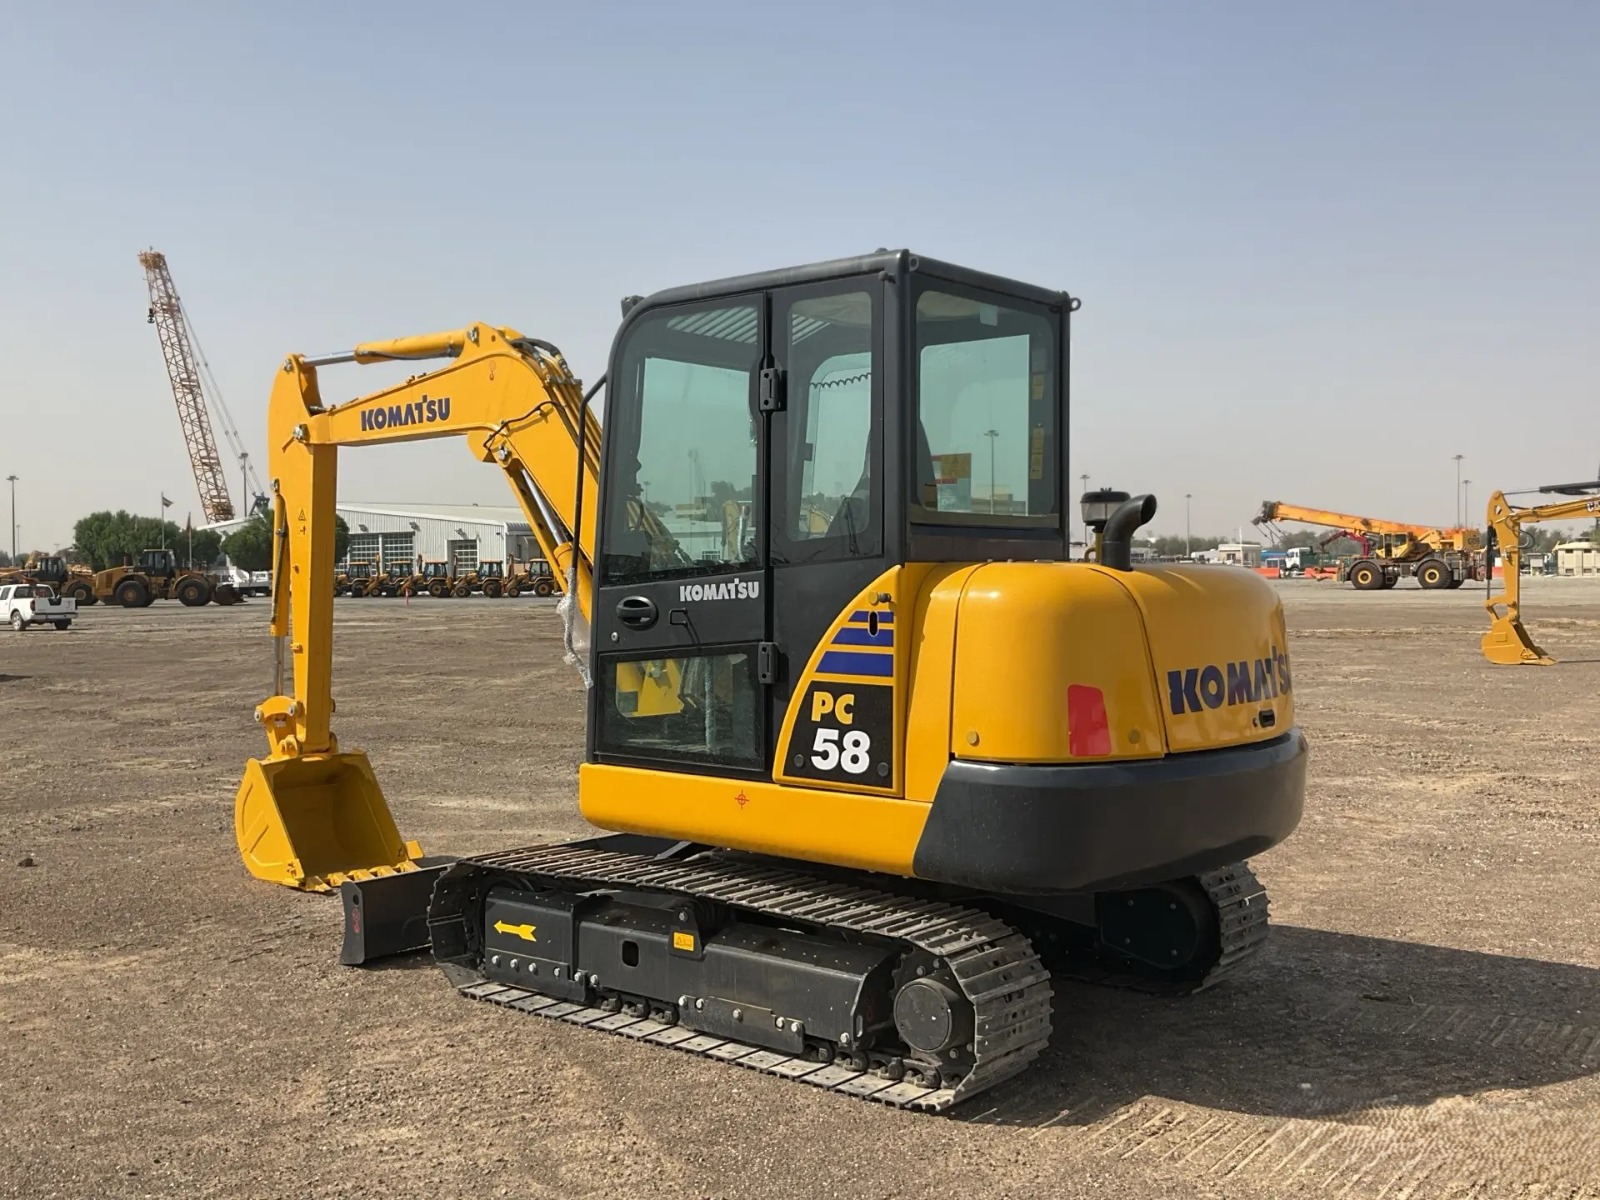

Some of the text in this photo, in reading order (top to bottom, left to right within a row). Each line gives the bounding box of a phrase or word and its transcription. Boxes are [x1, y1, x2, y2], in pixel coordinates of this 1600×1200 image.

[361, 394, 450, 431] KOMATSU
[680, 578, 759, 602] KOMATSU
[811, 691, 855, 725] PC
[810, 728, 871, 774] 58
